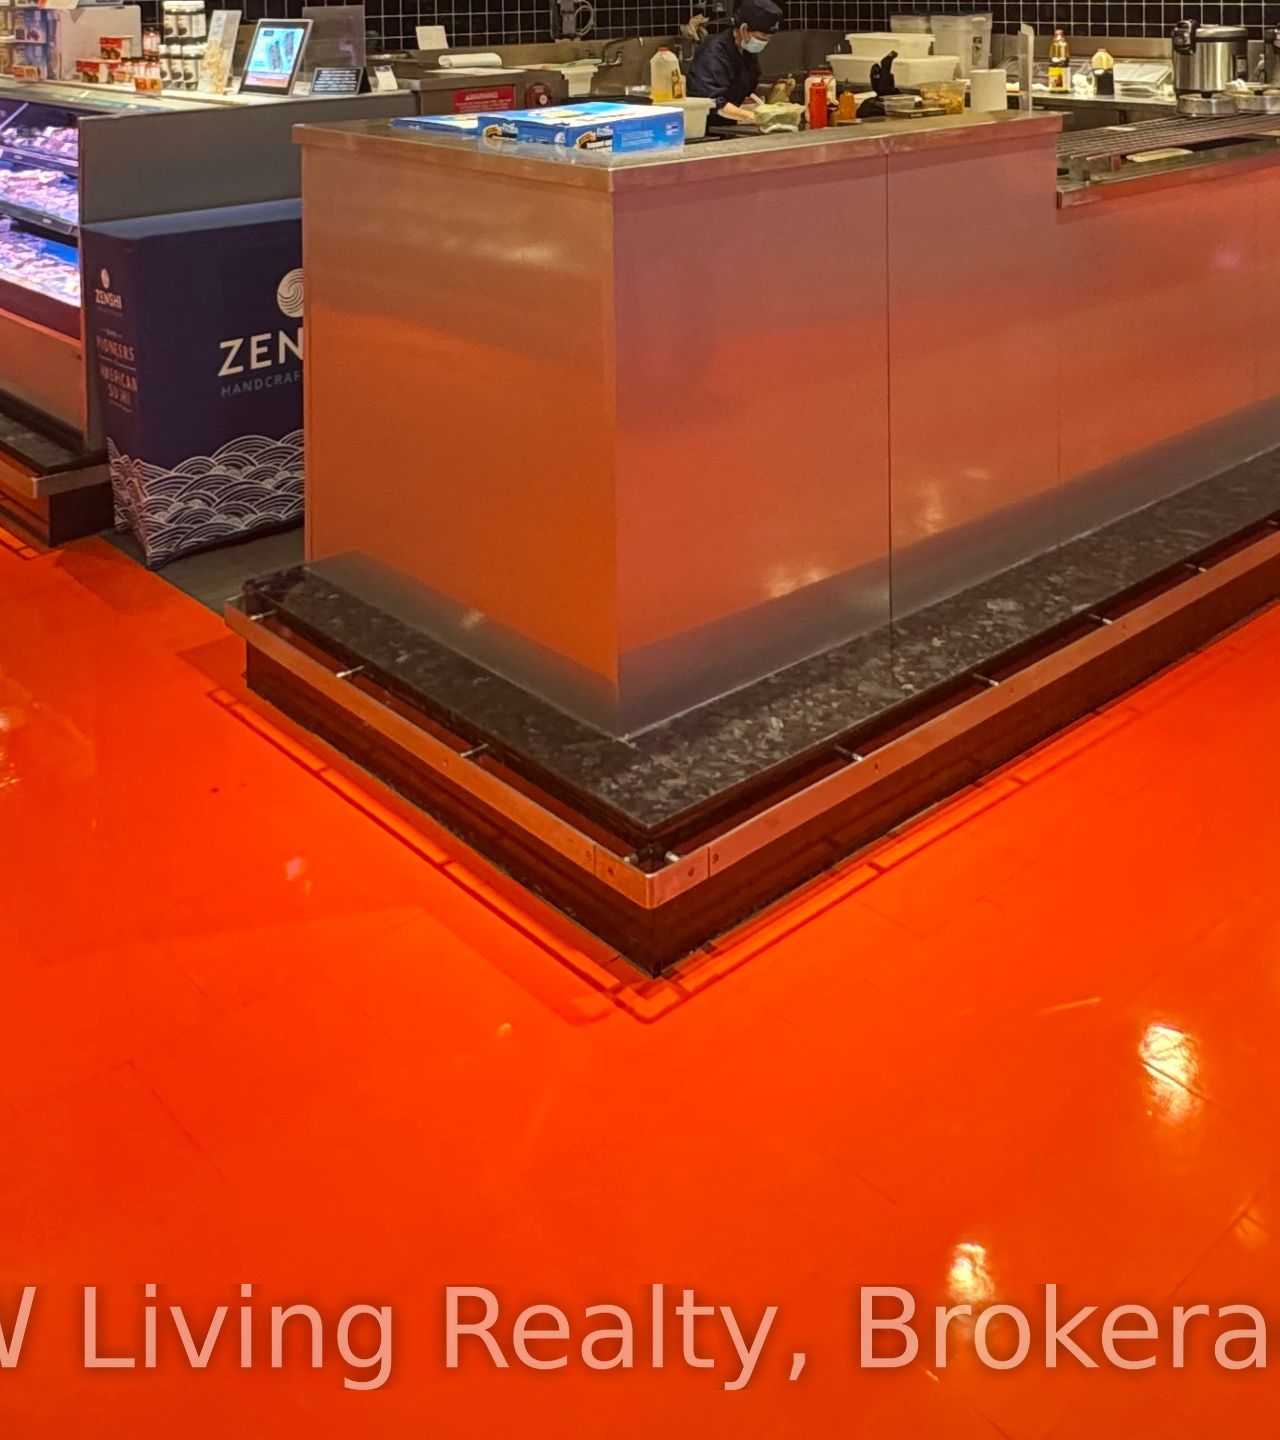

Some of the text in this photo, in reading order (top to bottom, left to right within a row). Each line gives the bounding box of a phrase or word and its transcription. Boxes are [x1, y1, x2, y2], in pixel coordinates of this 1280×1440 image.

[94, 288, 122, 310] ZENSHI
[217, 327, 304, 377] ZEN
[220, 371, 301, 398] HANDCRAF
